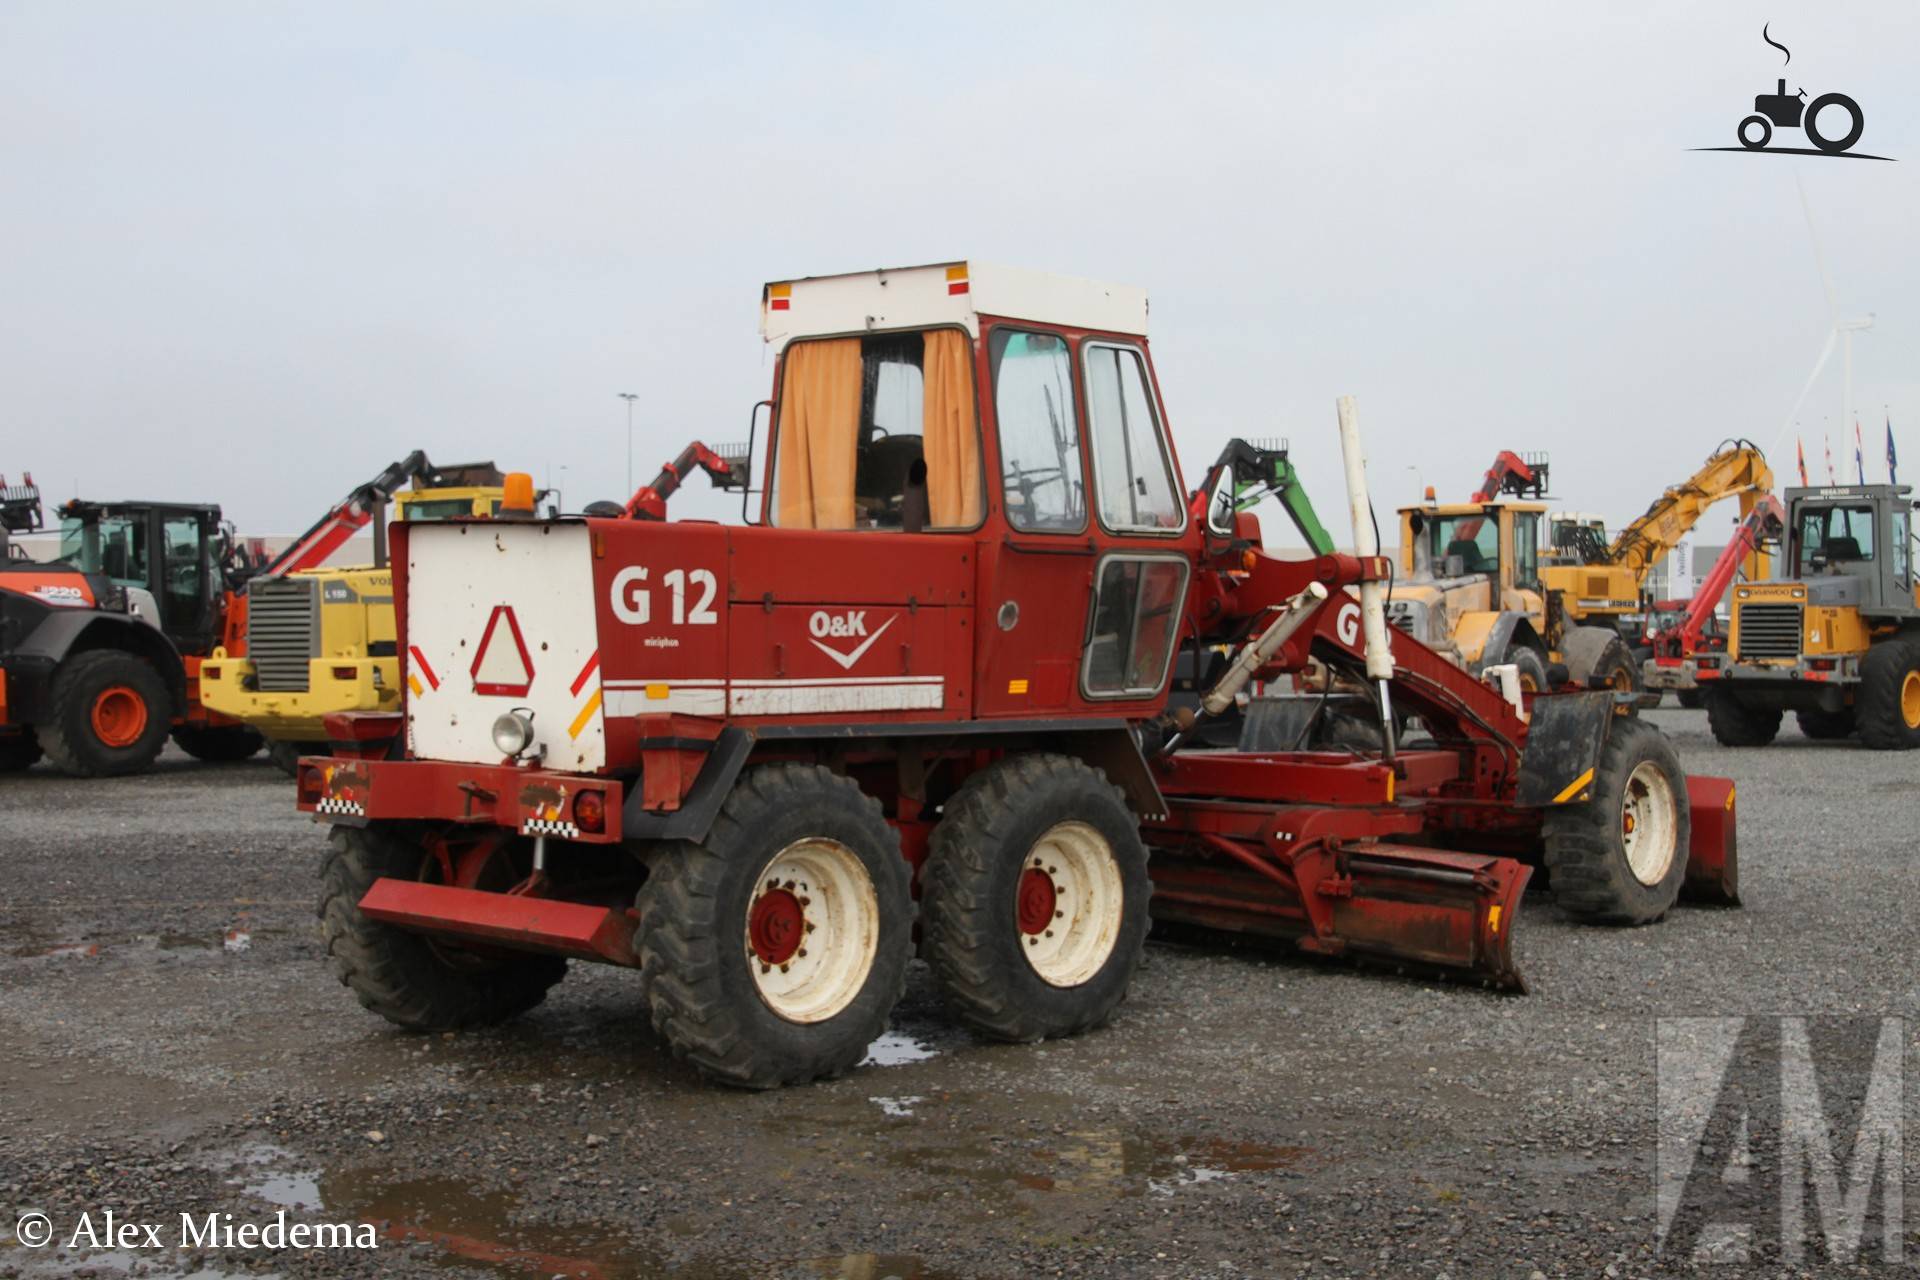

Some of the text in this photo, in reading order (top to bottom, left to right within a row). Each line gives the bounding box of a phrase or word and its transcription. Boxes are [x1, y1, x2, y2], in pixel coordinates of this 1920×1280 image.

[610, 565, 718, 625] G 12
[808, 610, 868, 638] O&K
